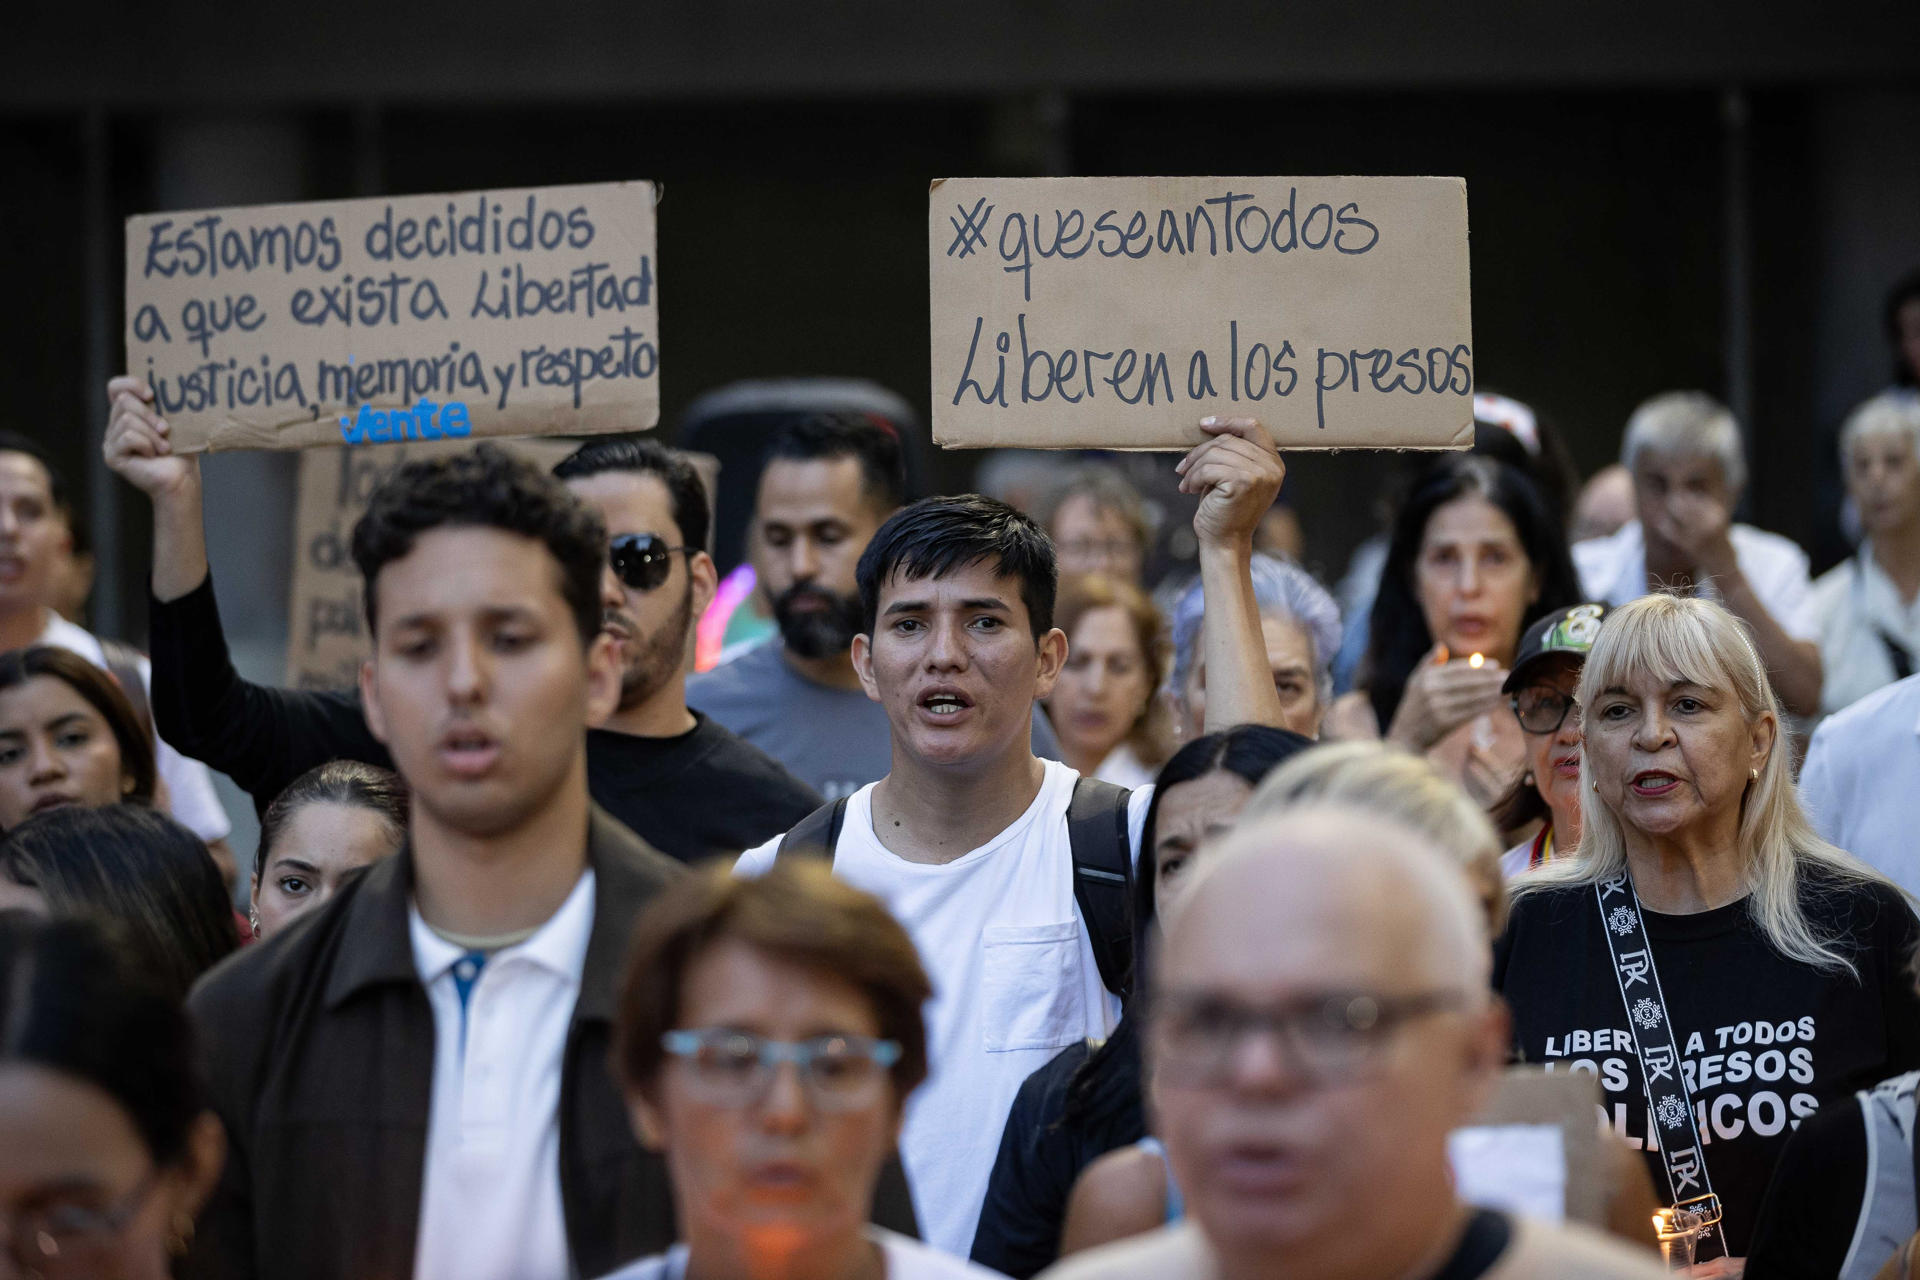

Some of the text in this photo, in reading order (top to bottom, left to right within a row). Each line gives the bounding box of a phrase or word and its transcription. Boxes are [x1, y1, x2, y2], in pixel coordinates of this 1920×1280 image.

[364, 195, 596, 261] decididos
[133, 304, 172, 343] a
[181, 294, 267, 358] que
[290, 272, 449, 328] exista
[317, 341, 490, 407] memoria
[493, 362, 516, 411] y
[521, 325, 658, 410] respeto
[952, 313, 1472, 429] Liberen a los presos
[1643, 1047, 1815, 1098] RESOS
[1684, 1032, 1705, 1056] A
[1714, 1016, 1816, 1049] TODOS
